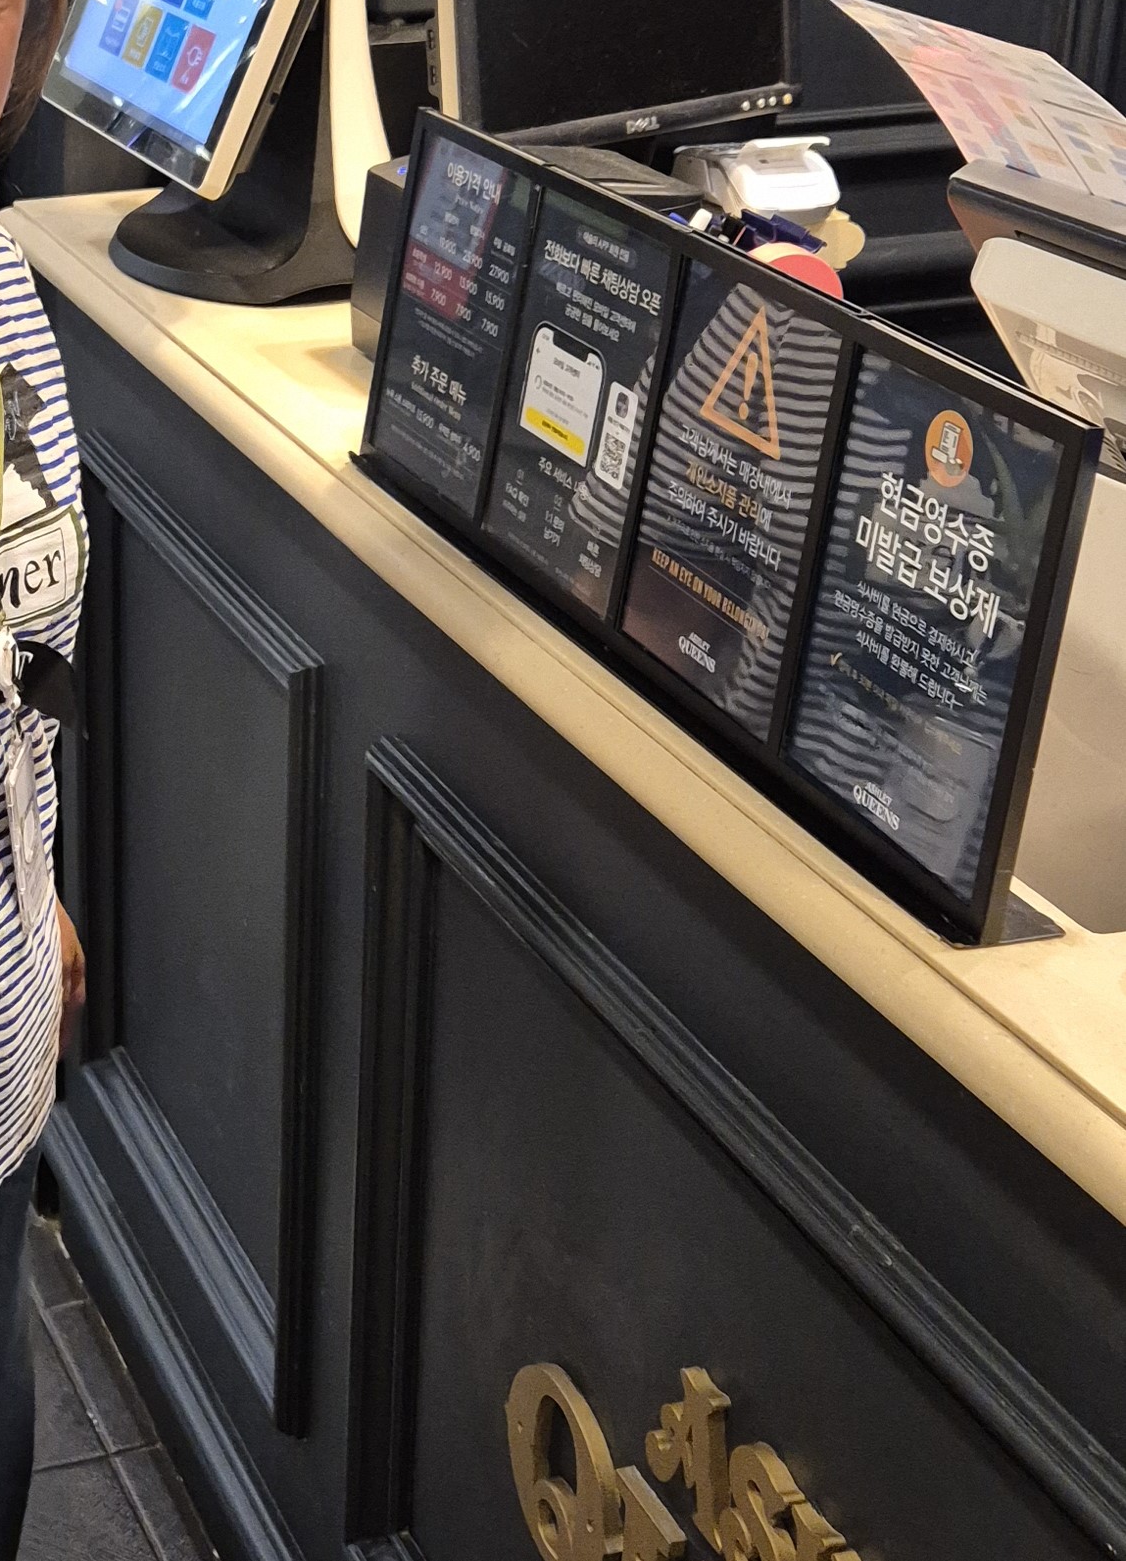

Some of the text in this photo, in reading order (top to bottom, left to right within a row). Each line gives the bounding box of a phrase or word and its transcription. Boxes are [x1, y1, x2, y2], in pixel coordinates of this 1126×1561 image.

[627, 115, 660, 135] DELL
[446, 159, 481, 194] 이용가격
[482, 177, 501, 204] 안내
[543, 239, 661, 316] 전화보다 빠른 채팅상담 오픈
[410, 354, 429, 382] 추가
[429, 366, 448, 393] 주문
[448, 379, 466, 406] 메뉴
[537, 456, 552, 476] 주요
[677, 423, 793, 508] 고객님께서는 매장내에서
[684, 457, 772, 532] 개인소지품 관리에
[666, 477, 706, 521] 주의하여
[706, 506, 738, 542] 주시기
[737, 527, 782, 570] 바랍니다
[875, 469, 994, 570] 현금영수증
[651, 546, 670, 569] KEEP
[678, 566, 693, 587] EYE
[702, 583, 722, 608] YOUR
[855, 516, 921, 587] 미발급
[923, 558, 999, 637] 보상제
[677, 635, 716, 673] QUEENS
[855, 580, 978, 672] 식사비를 현금으로 결제하시고
[884, 623, 919, 659] 발급받지
[920, 647, 940, 672] 못한
[854, 629, 958, 713] 식사비를 환불해 드립니다
[851, 781, 900, 830] QUEENS
